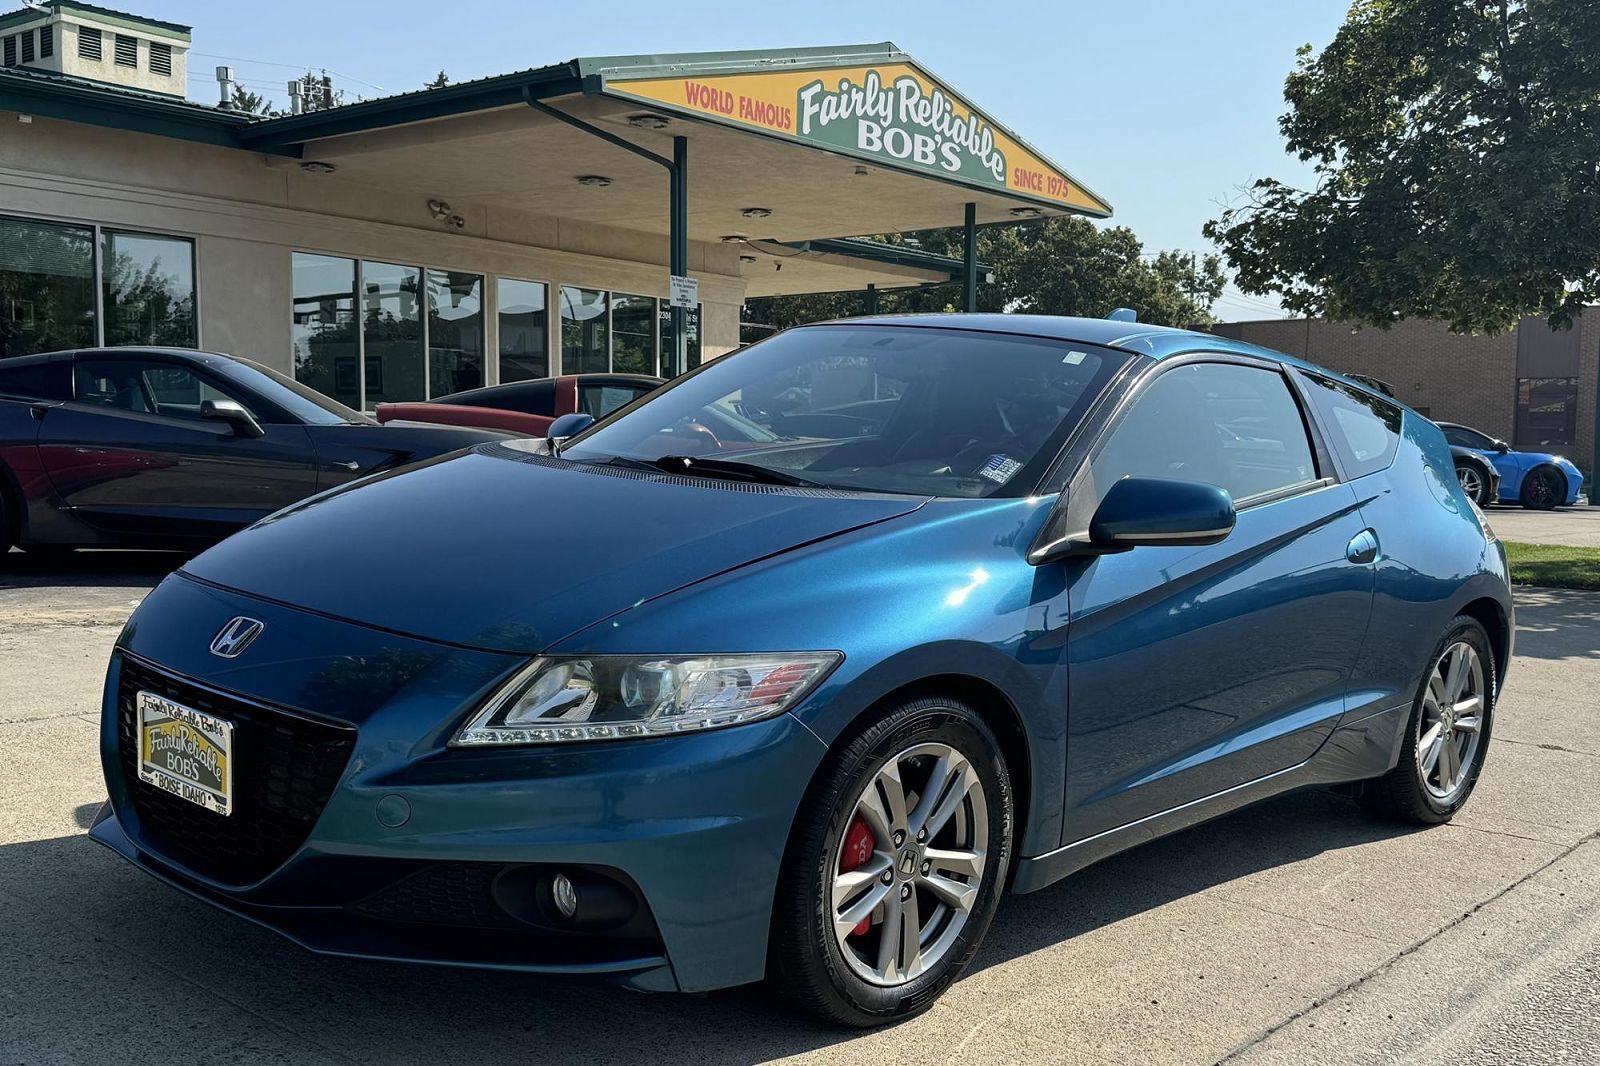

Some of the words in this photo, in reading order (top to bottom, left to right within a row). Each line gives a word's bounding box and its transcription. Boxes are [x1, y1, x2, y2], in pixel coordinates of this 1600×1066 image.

[685, 81, 734, 114] WORLD
[739, 95, 791, 129] FAMOUS
[800, 73, 894, 135] Fairly
[896, 78, 1005, 182] Reliable
[857, 119, 962, 172] BOB'S
[1013, 167, 1043, 192] SINCE
[1047, 175, 1069, 198] 1975
[142, 694, 168, 714] Fairly
[167, 703, 201, 727] Reliable
[199, 714, 224, 737] Bob's
[150, 725, 182, 754] Fairly
[179, 725, 222, 782] Reliable
[167, 751, 200, 781] BOB'S
[158, 773, 181, 797] BOISE
[182, 784, 207, 806] IDAHO
